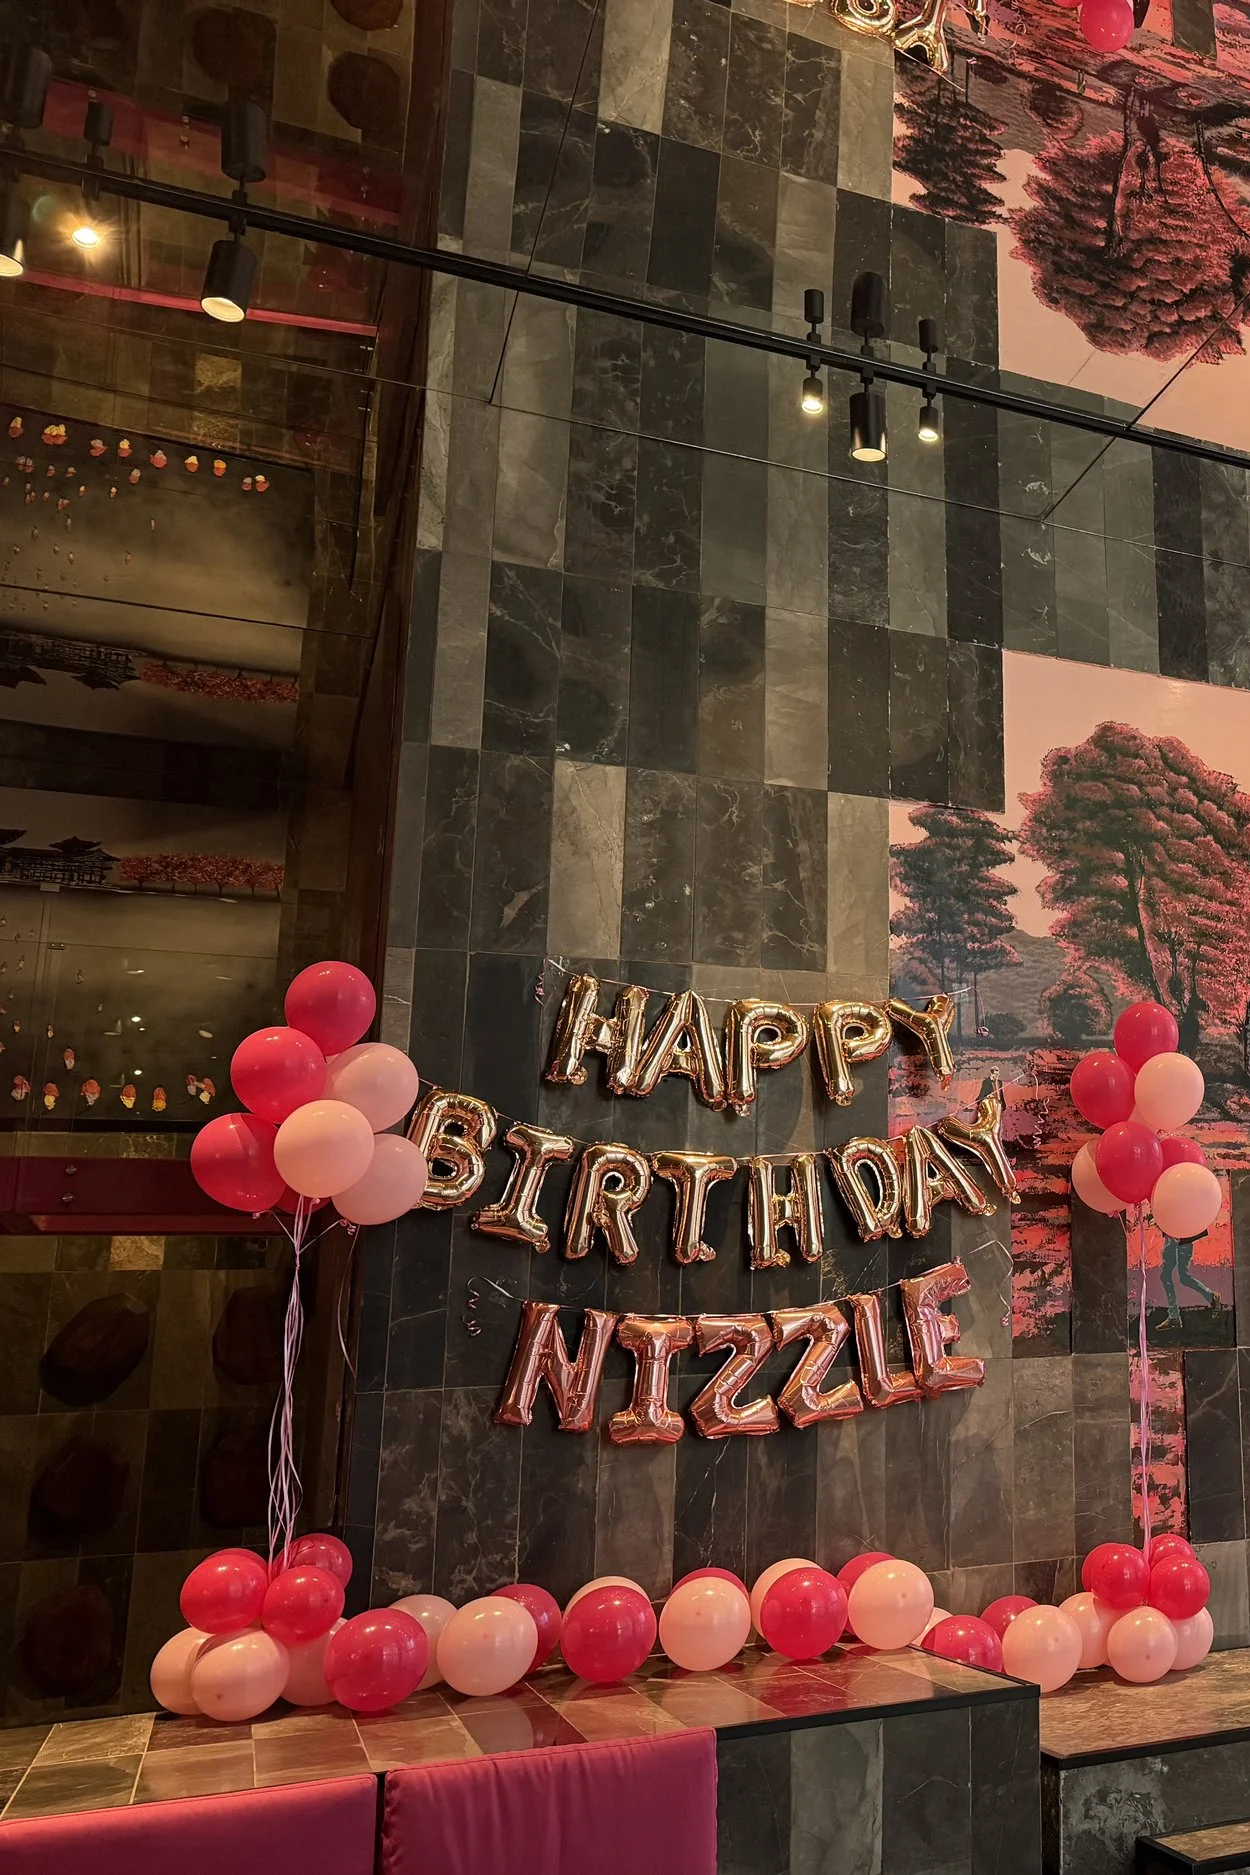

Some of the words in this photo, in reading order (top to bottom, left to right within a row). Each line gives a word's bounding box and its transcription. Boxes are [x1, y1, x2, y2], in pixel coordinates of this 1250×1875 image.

[547, 974, 955, 1115] HAPPY
[407, 1088, 1021, 1269] BIRTHDAY
[494, 1257, 985, 1446] NIZZLE
